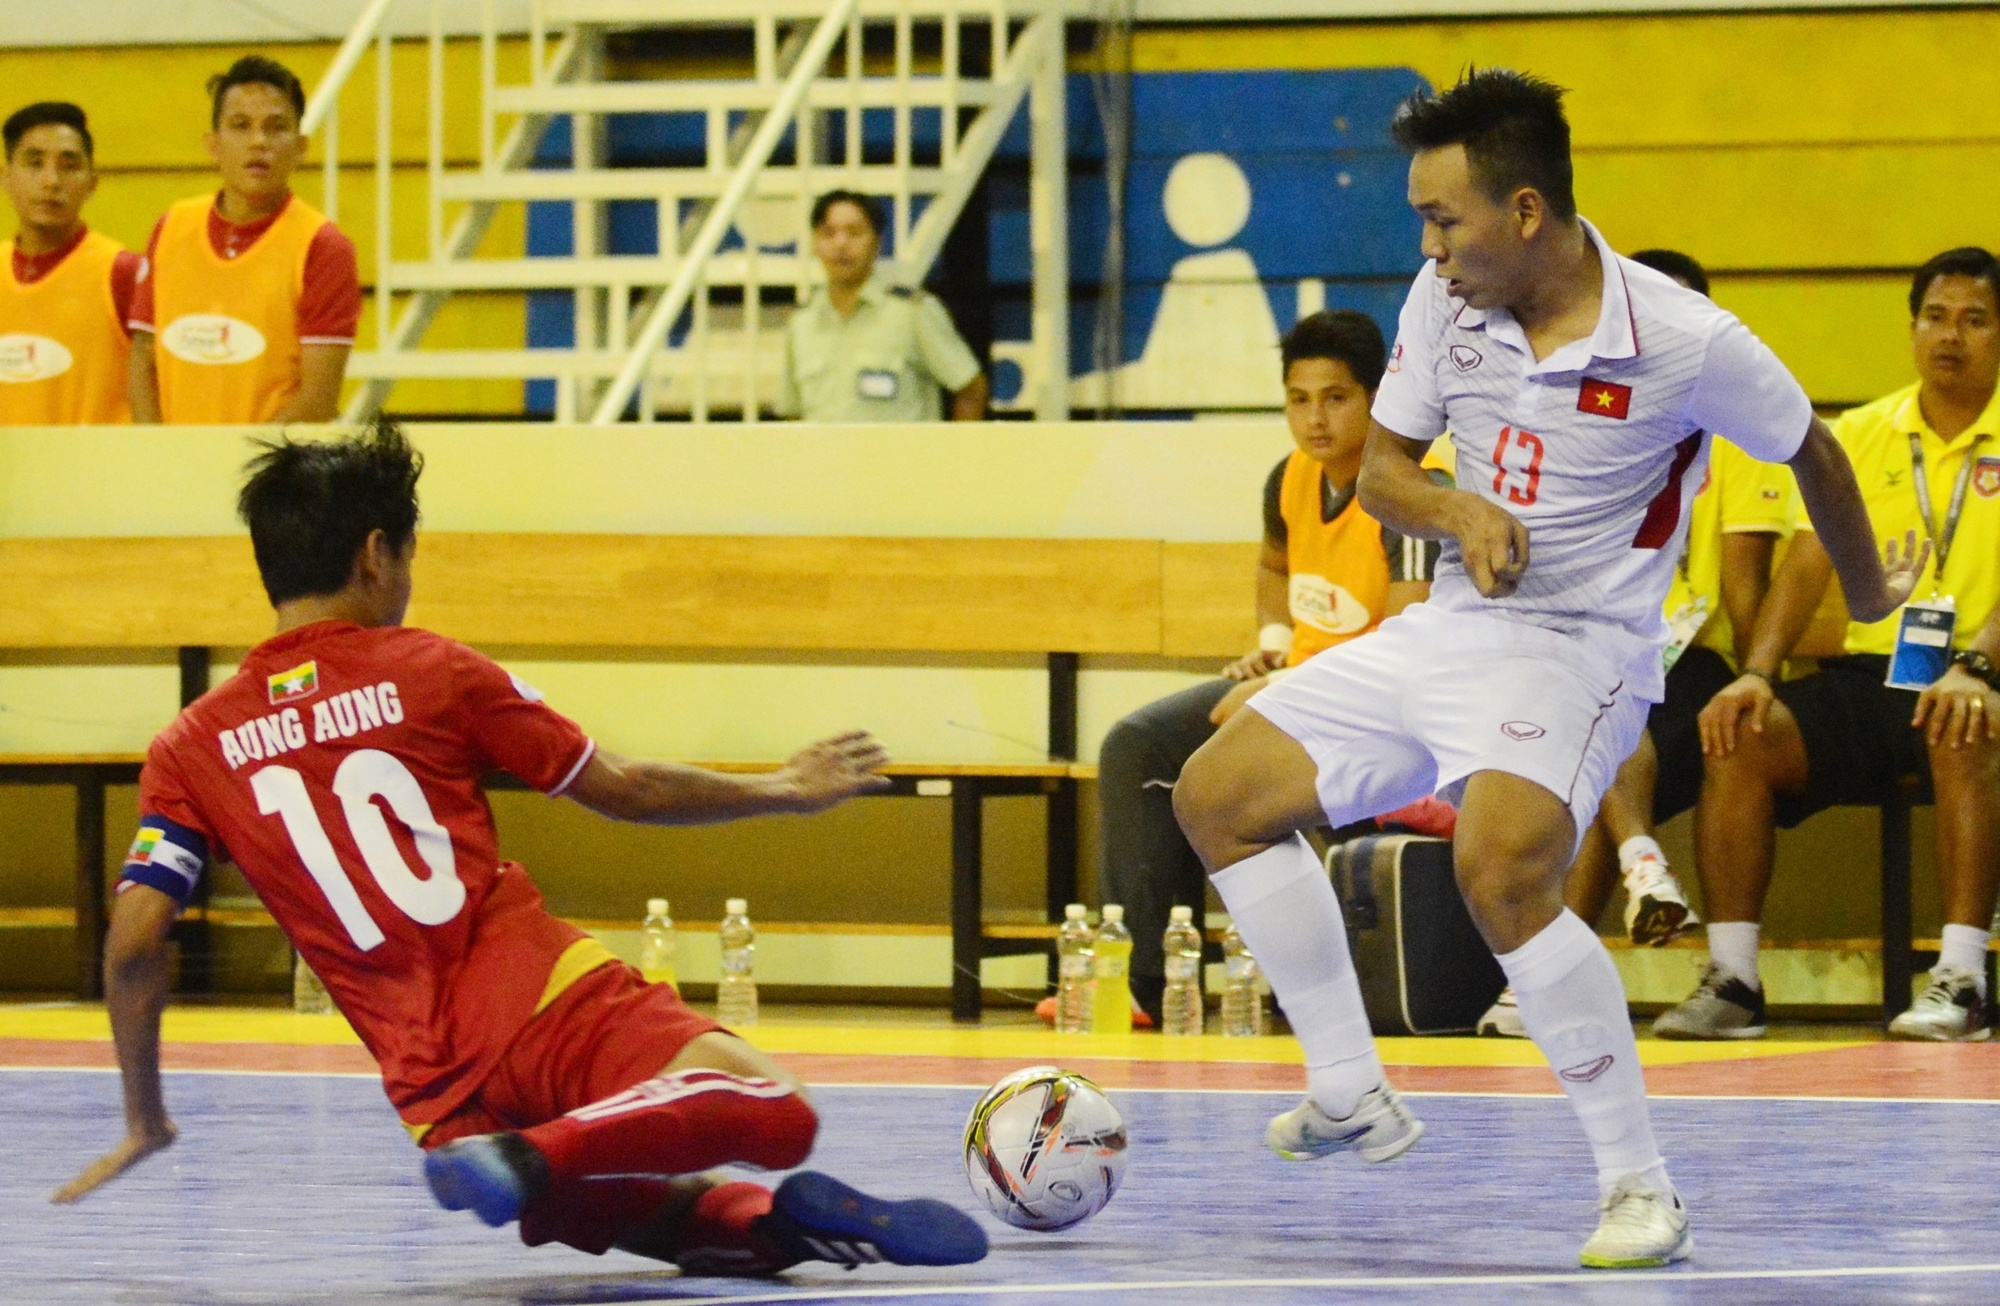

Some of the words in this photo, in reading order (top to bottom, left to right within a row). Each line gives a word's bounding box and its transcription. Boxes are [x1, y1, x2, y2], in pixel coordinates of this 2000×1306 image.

[1493, 425, 1544, 506] 13
[219, 708, 306, 770] AUNG
[313, 681, 404, 743] AUNG
[249, 748, 467, 952] 10
